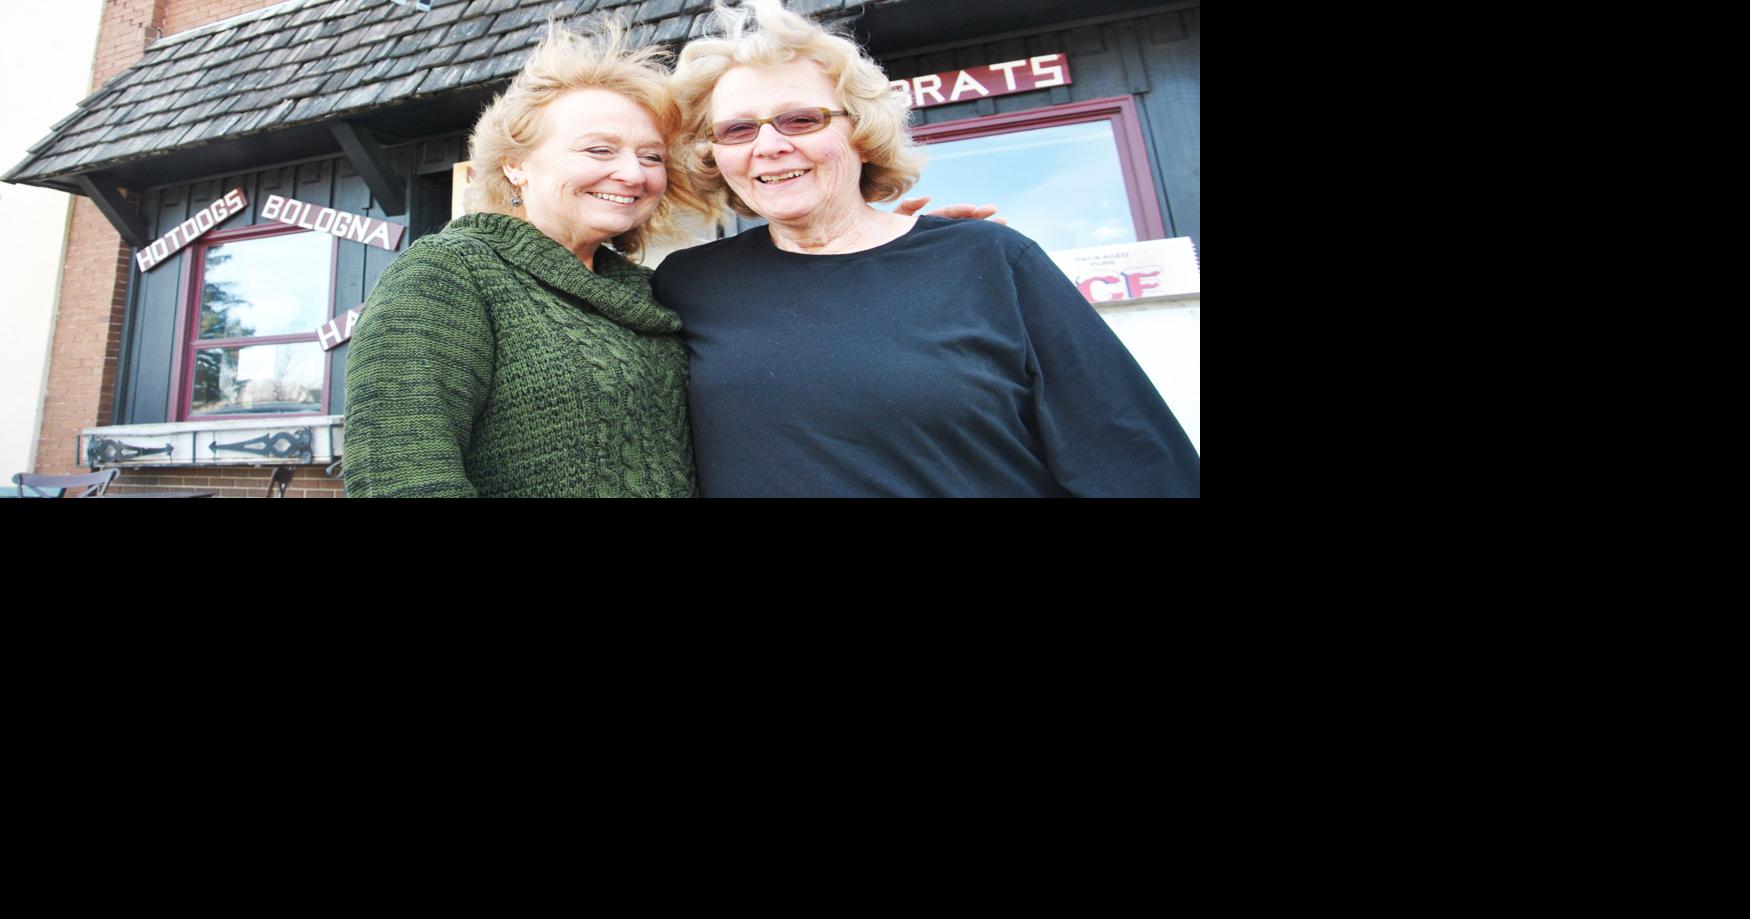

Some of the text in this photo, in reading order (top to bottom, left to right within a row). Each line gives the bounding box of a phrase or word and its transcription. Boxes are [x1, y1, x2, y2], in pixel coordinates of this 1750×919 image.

[889, 54, 1062, 107] BRATS
[136, 188, 246, 272] HOTDOGS
[262, 194, 390, 250] BOLOGNA
